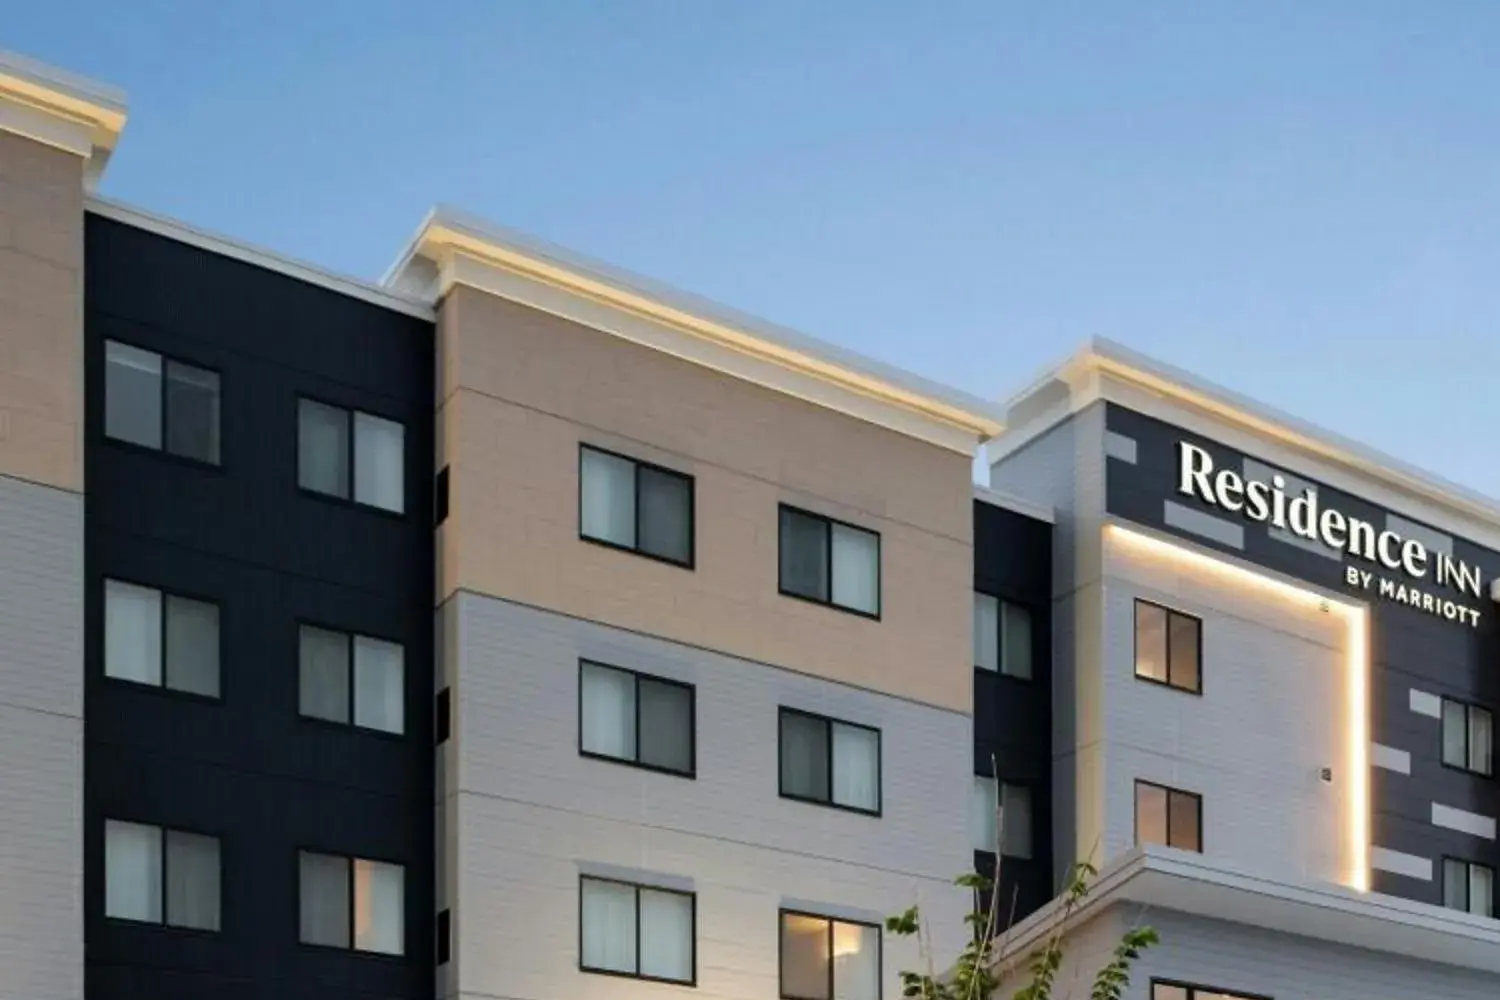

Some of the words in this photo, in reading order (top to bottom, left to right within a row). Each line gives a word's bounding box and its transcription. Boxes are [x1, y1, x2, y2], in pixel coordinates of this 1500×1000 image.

[1179, 440, 1427, 577] Residence
[1437, 552, 1481, 598] INN
[1346, 565, 1373, 589] BY
[1380, 578, 1481, 627] MARRIOTT
